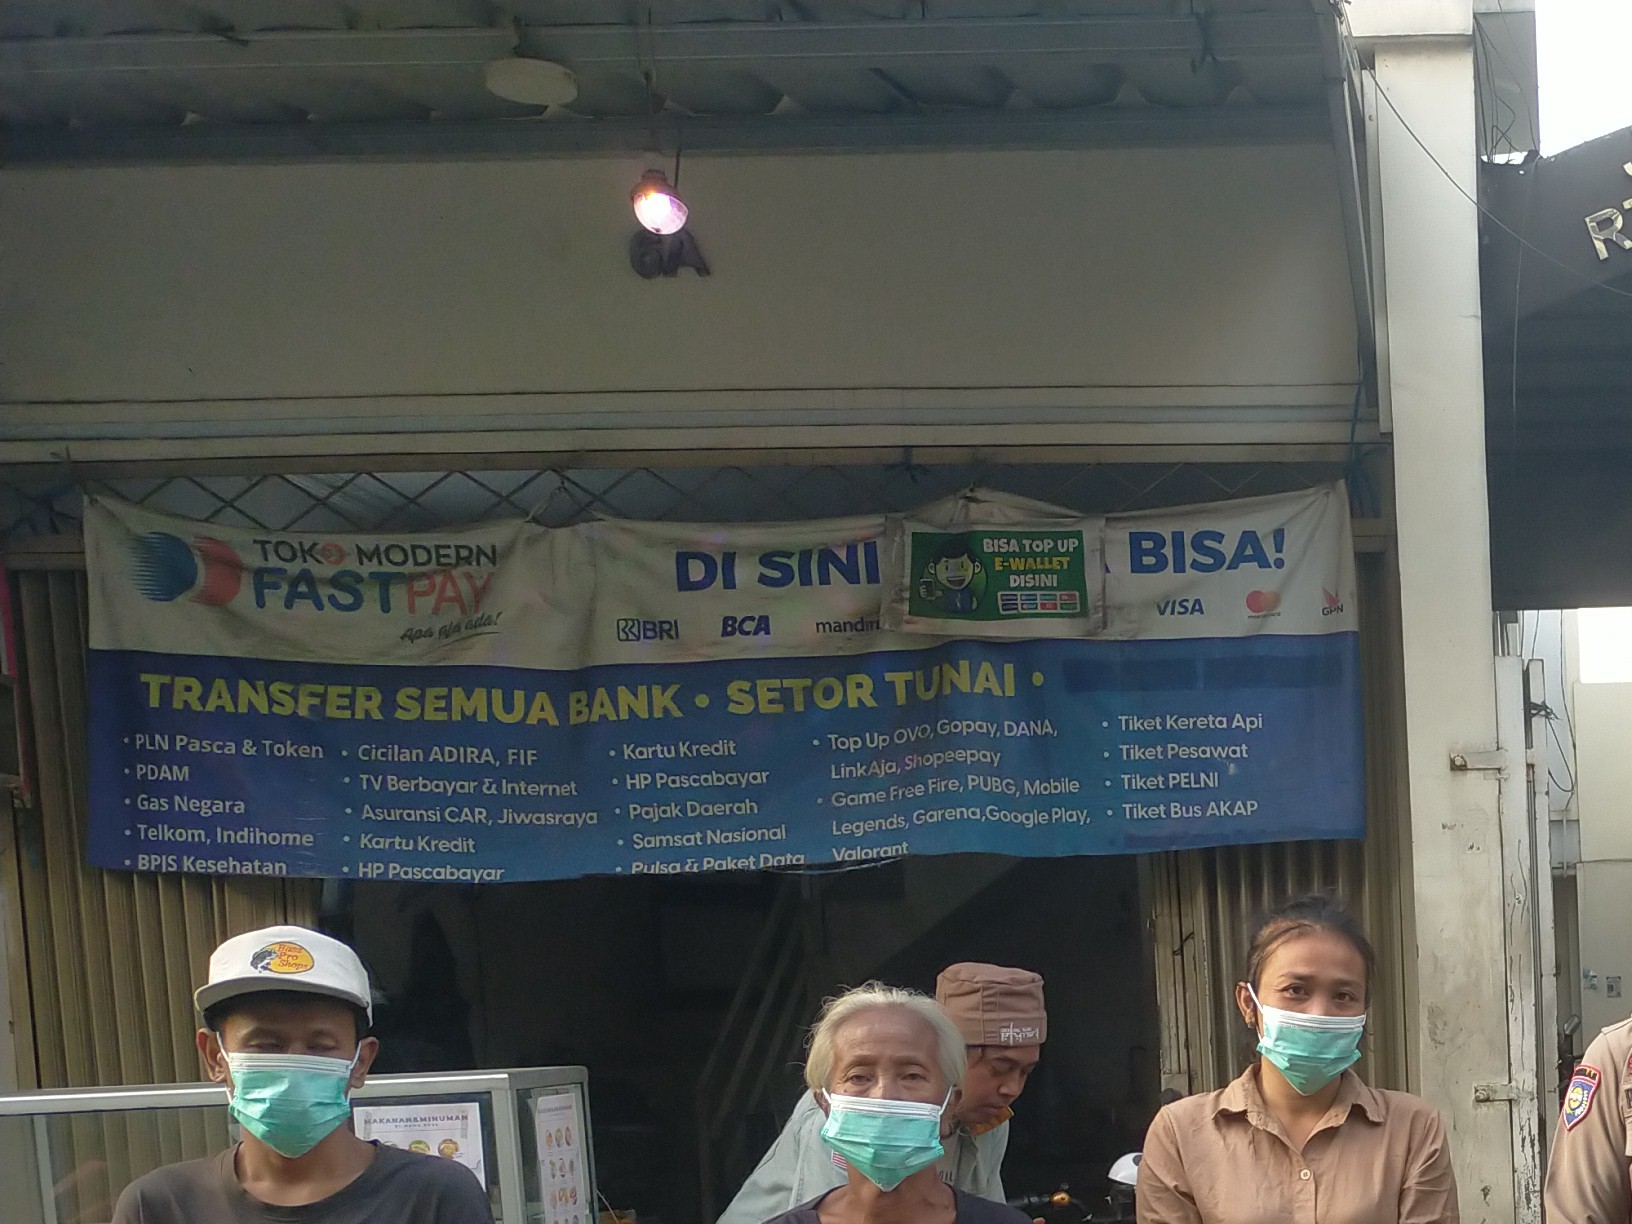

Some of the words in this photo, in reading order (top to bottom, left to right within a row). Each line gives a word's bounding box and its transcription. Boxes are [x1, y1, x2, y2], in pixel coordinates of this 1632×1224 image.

[355, 543, 497, 567] MODERN
[983, 538, 1020, 553] BISA
[1022, 538, 1054, 553] TOP
[1057, 538, 1079, 553] UP
[1128, 528, 1285, 574] BISA!
[675, 551, 737, 592] DI
[758, 540, 881, 588] SINI
[994, 557, 1070, 571] E-WALLET
[253, 566, 496, 615] FASTPAY
[1009, 574, 1058, 588] DISINI
[1157, 598, 1205, 616] VISA
[642, 619, 679, 640] BRI
[721, 615, 771, 637] BCA
[140, 673, 384, 720] TRANSFER
[394, 687, 560, 726] SEMUA
[569, 684, 684, 725] BANK
[727, 673, 878, 714] SETOR
[885, 660, 1015, 706] TUNAI
[1118, 714, 1162, 732] Tiket
[1166, 713, 1228, 730] Kereta
[1231, 713, 1263, 732] Api
[136, 733, 169, 750] PLN
[175, 735, 235, 755] Pasca
[242, 740, 257, 756] &
[262, 740, 324, 759] Token
[827, 733, 862, 752] Top
[866, 731, 890, 749] Up
[893, 724, 934, 745] OVO,
[937, 719, 1000, 738] Gopay,
[1004, 719, 1058, 737] DANA,
[358, 745, 423, 762] Cicilan
[429, 746, 500, 767] ADIRA,
[508, 749, 538, 766] FIF
[623, 743, 675, 760] Kartu
[679, 740, 737, 757] Kredit
[904, 749, 1001, 771] Shopeepay
[1119, 744, 1163, 760] Tiket
[1167, 743, 1248, 759] Pesawat
[136, 764, 190, 781] PDAM
[626, 773, 651, 790] HP
[656, 769, 769, 790] Pascabayar
[1121, 773, 1165, 790] Tiket
[1169, 772, 1219, 789] PELNI
[360, 774, 382, 791] TV
[387, 776, 478, 797] Berbayar
[482, 778, 497, 794] &
[502, 779, 578, 797] Internet
[831, 787, 887, 807] Game
[890, 781, 925, 801] Free
[928, 777, 964, 795] Fire,
[967, 774, 1020, 797] PUBG,
[1023, 778, 1080, 795] Mobile
[137, 794, 169, 811] Gas
[174, 795, 245, 817] Negara
[361, 804, 441, 822] Asuransi
[445, 807, 493, 826] CAR,
[497, 808, 598, 829] Jiwasraya
[629, 803, 683, 823] Pajak
[686, 799, 758, 817] Daerah
[1122, 802, 1166, 819] Tiket
[1170, 801, 1202, 818] Bus
[1206, 800, 1259, 817] AKAP
[832, 813, 910, 837] Legends,
[1052, 806, 1091, 825] Play,
[137, 825, 211, 844] Telkom,
[216, 827, 315, 847] Indihome
[360, 833, 413, 851] Kartu
[417, 835, 475, 853] Kredit
[633, 831, 702, 849] Samsat
[706, 825, 786, 845] Nasional
[832, 841, 909, 862] Valorant
[183, 855, 287, 875] Kesehatan
[358, 862, 384, 879] HP
[388, 862, 505, 884] Pascabayar
[631, 860, 681, 874] Pulsa
[685, 859, 699, 873] &
[703, 852, 756, 872] Paket
[759, 852, 805, 868] Data
